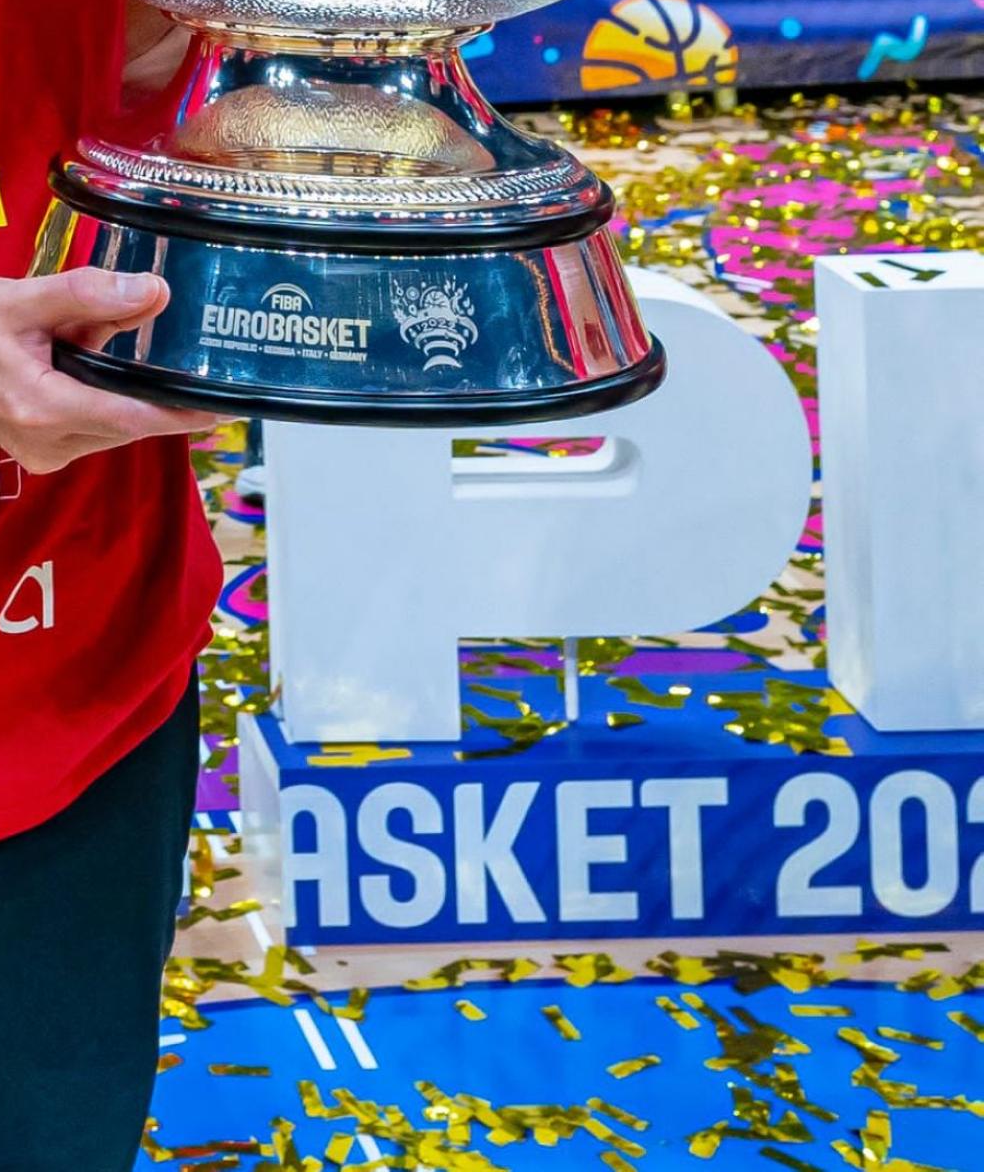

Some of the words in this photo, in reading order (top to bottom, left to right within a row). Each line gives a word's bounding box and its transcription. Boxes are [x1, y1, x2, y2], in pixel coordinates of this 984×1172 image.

[271, 293, 303, 312] FIBA
[201, 304, 372, 350] EUROBASKET
[772, 768, 984, 920] 20
